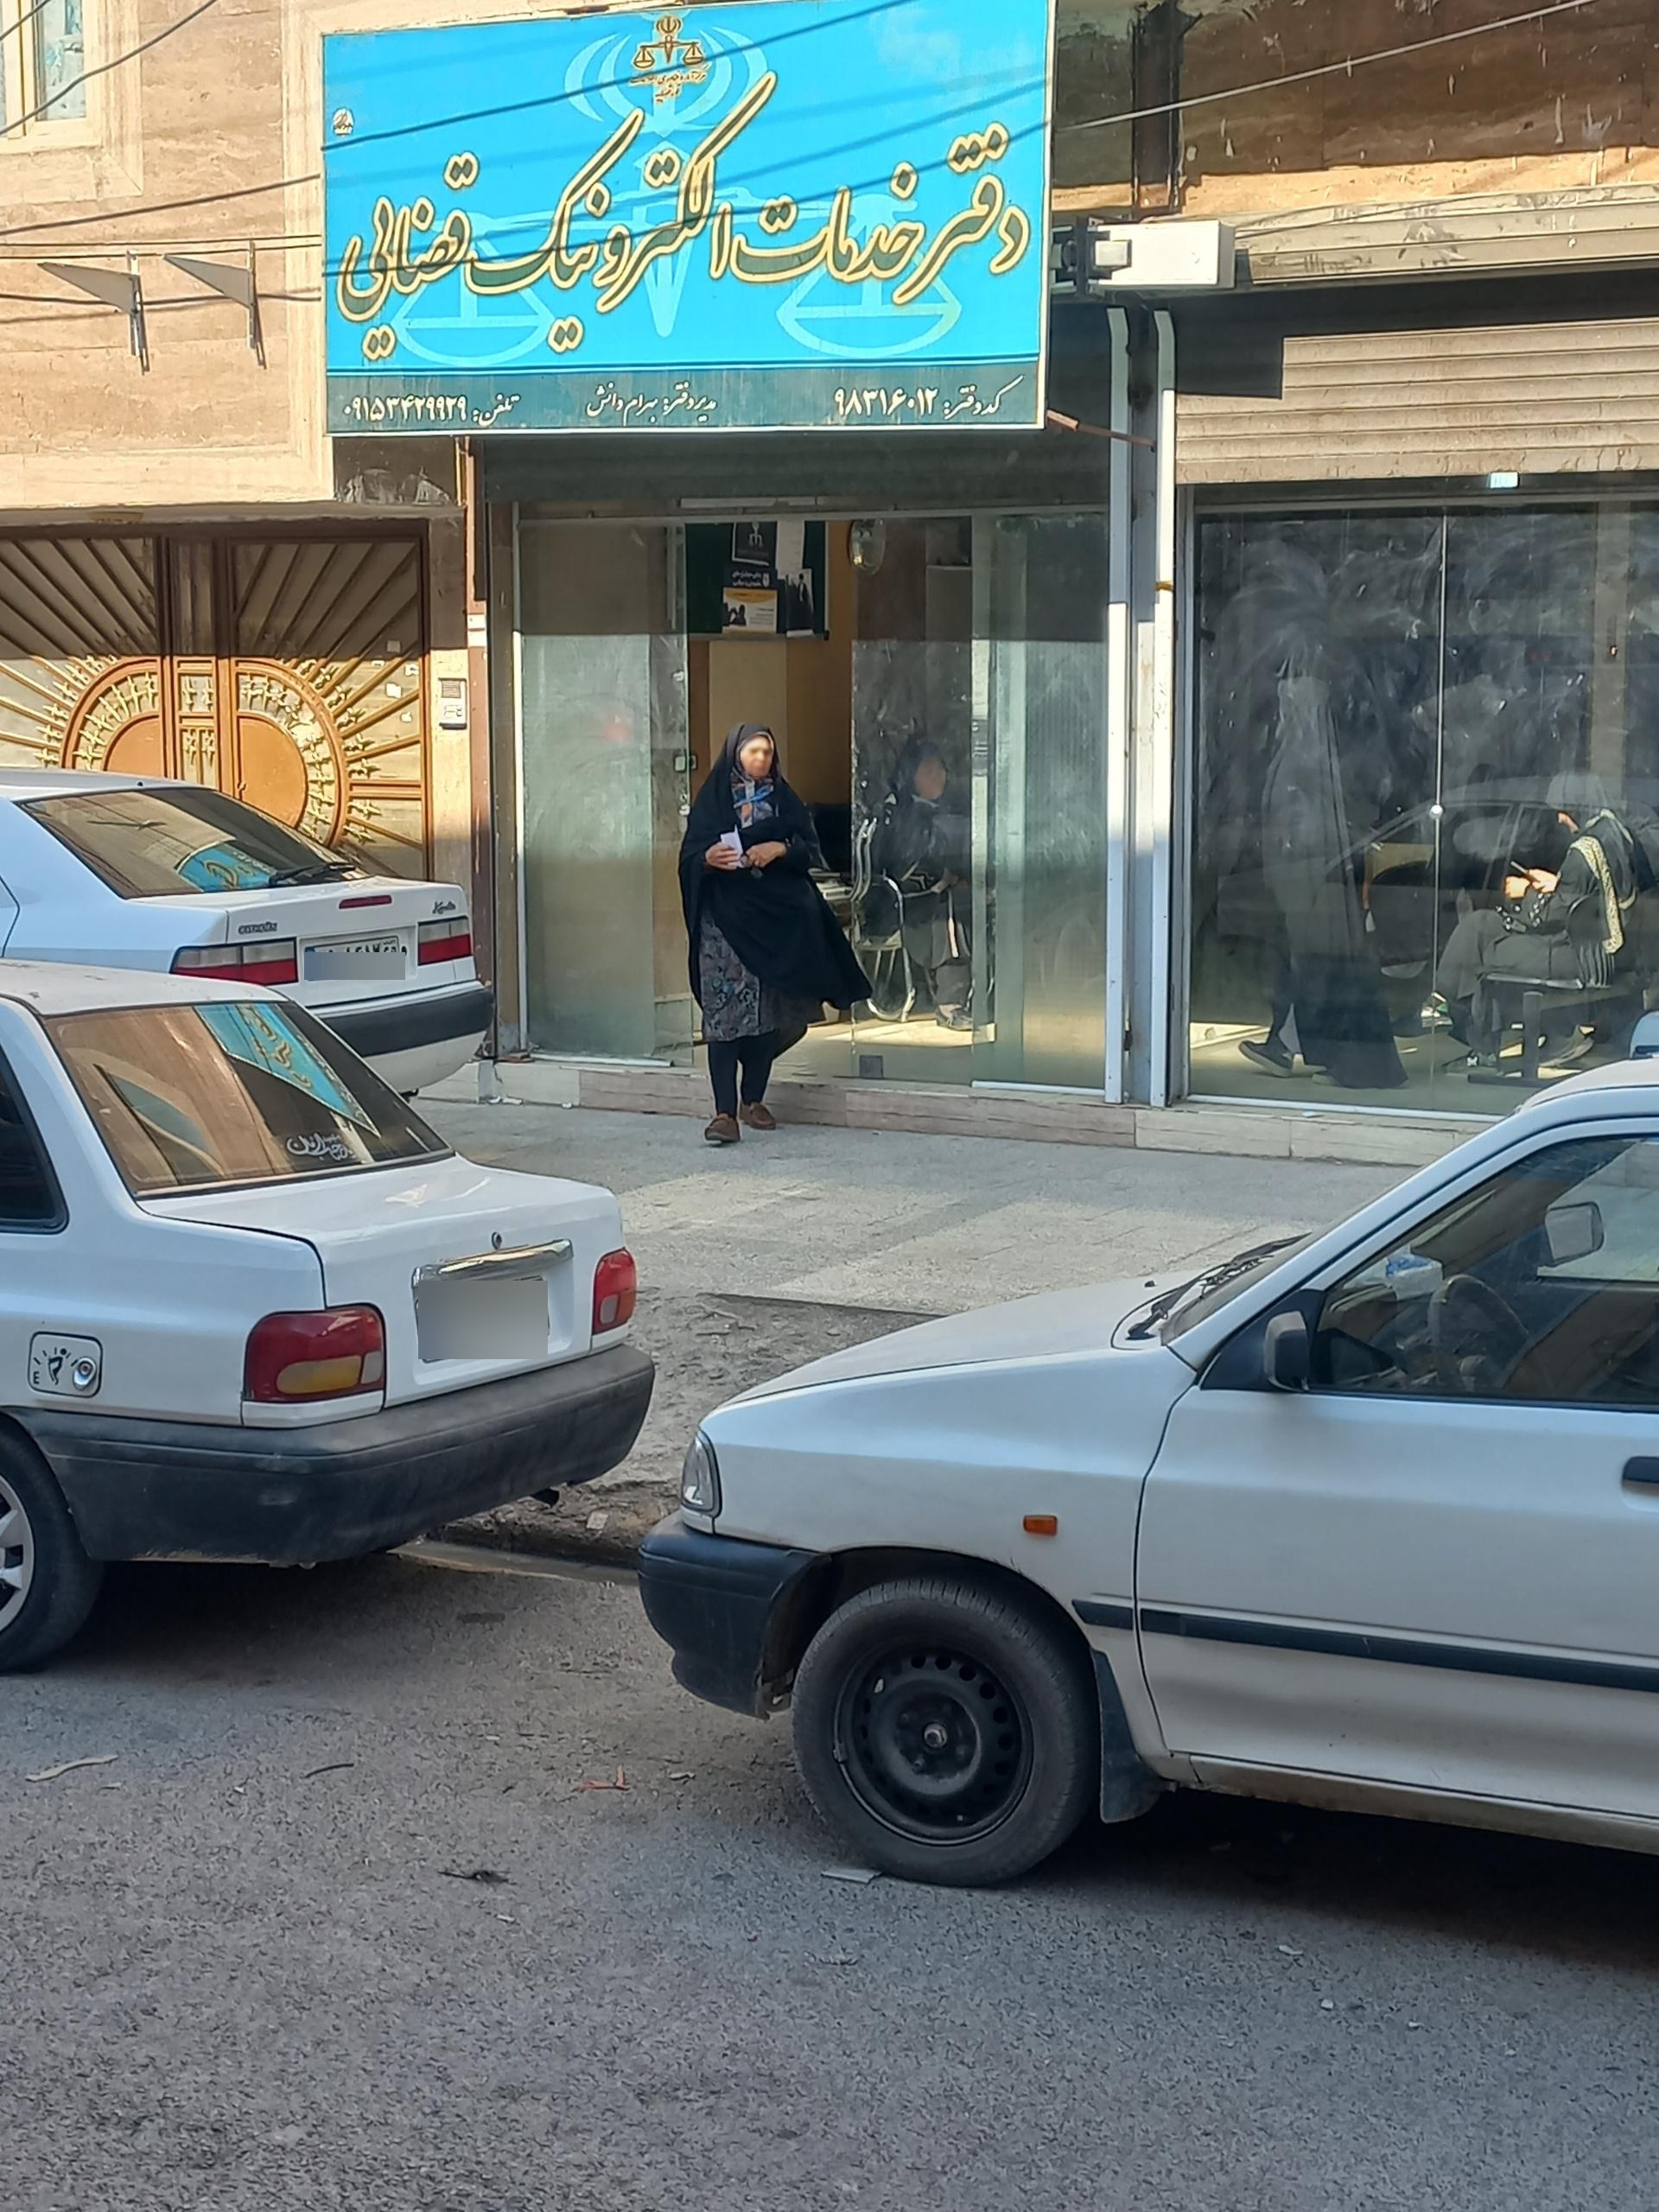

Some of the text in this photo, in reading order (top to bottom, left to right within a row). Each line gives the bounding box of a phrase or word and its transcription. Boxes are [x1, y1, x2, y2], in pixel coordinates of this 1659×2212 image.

[463, 72, 734, 355] الکترونیک
[729, 159, 926, 284] خدمات
[891, 121, 1031, 306] دفتر
[472, 392, 520, 427] تلفن:
[586, 381, 624, 417] دانش
[623, 393, 659, 427] بهرام
[693, 395, 717, 423] مدیر
[834, 388, 938, 416] ۹۸۳۱۶۰۱۲
[981, 374, 1026, 416] کد
[33, 1370, 40, 1384] E
